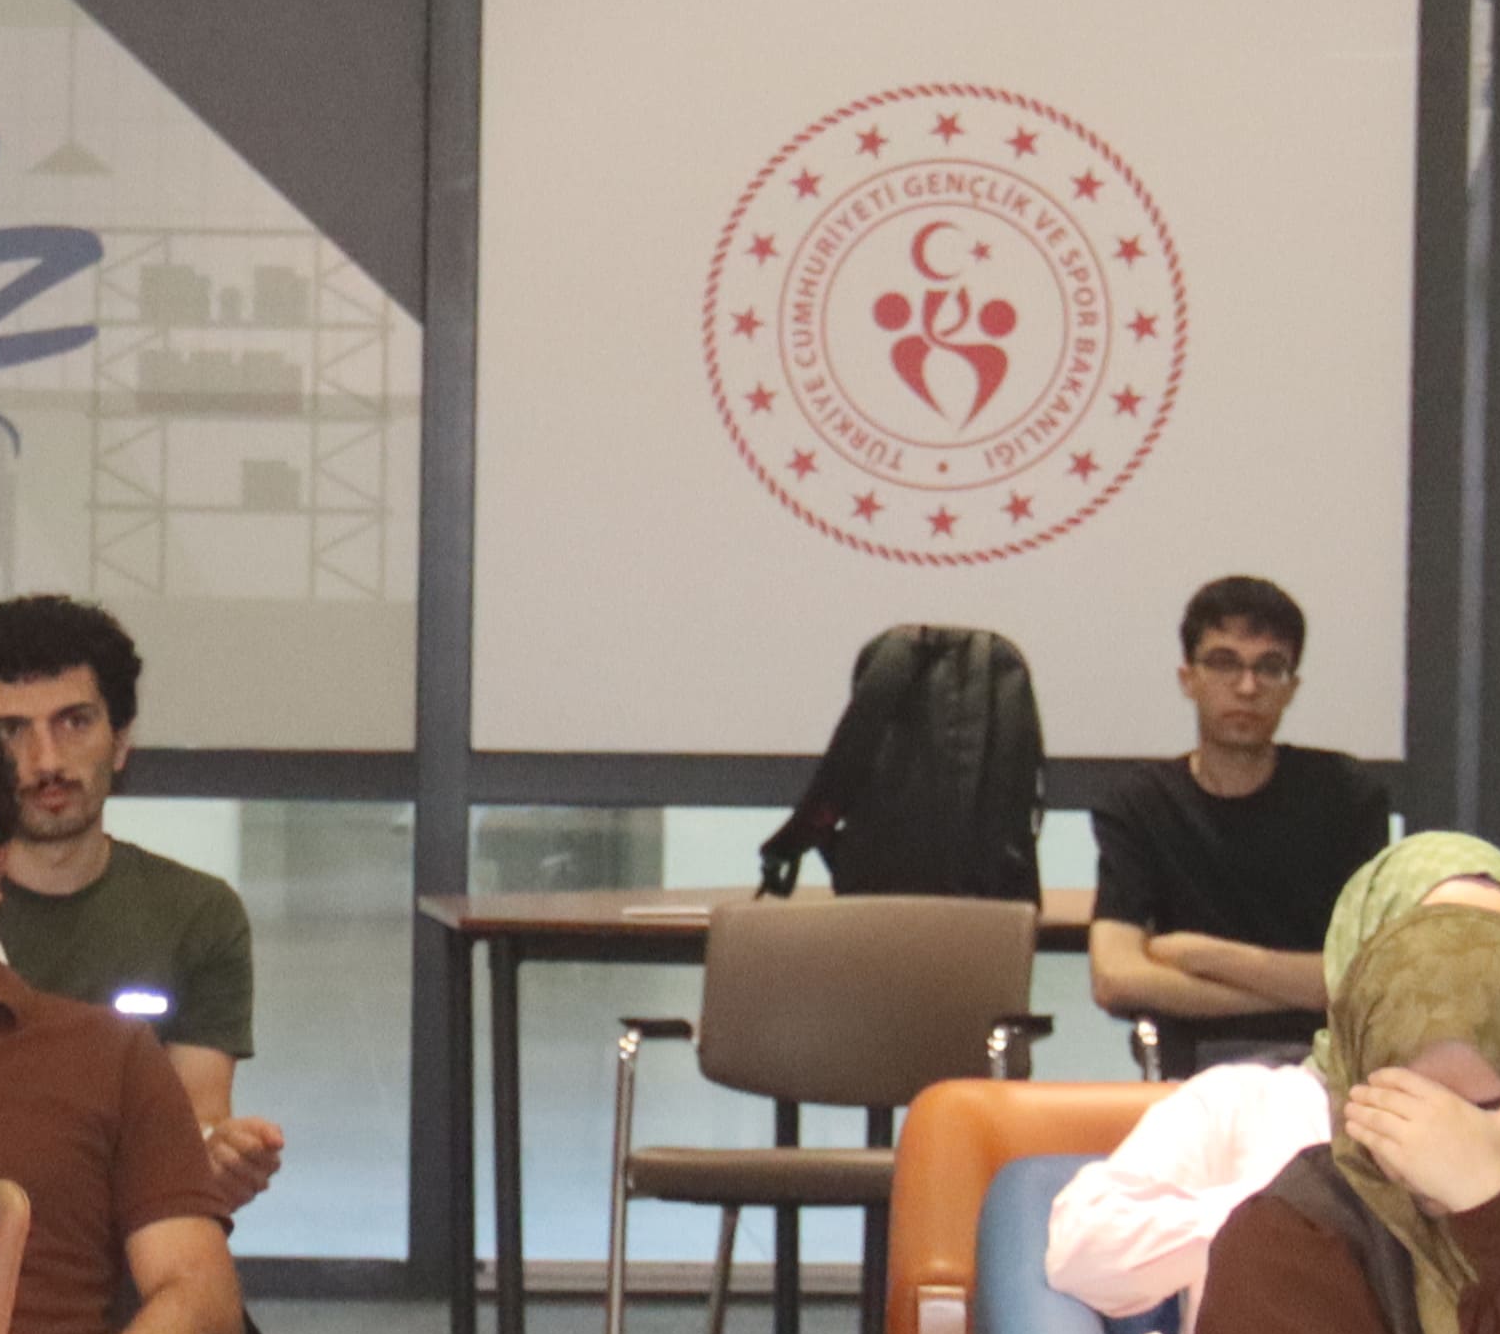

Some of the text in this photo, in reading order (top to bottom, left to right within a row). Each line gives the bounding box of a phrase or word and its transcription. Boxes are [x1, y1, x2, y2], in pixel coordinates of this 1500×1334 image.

[903, 172, 1031, 216] GENÇLİK
[1034, 210, 1069, 246] VE
[1059, 248, 1098, 328] SPOR
